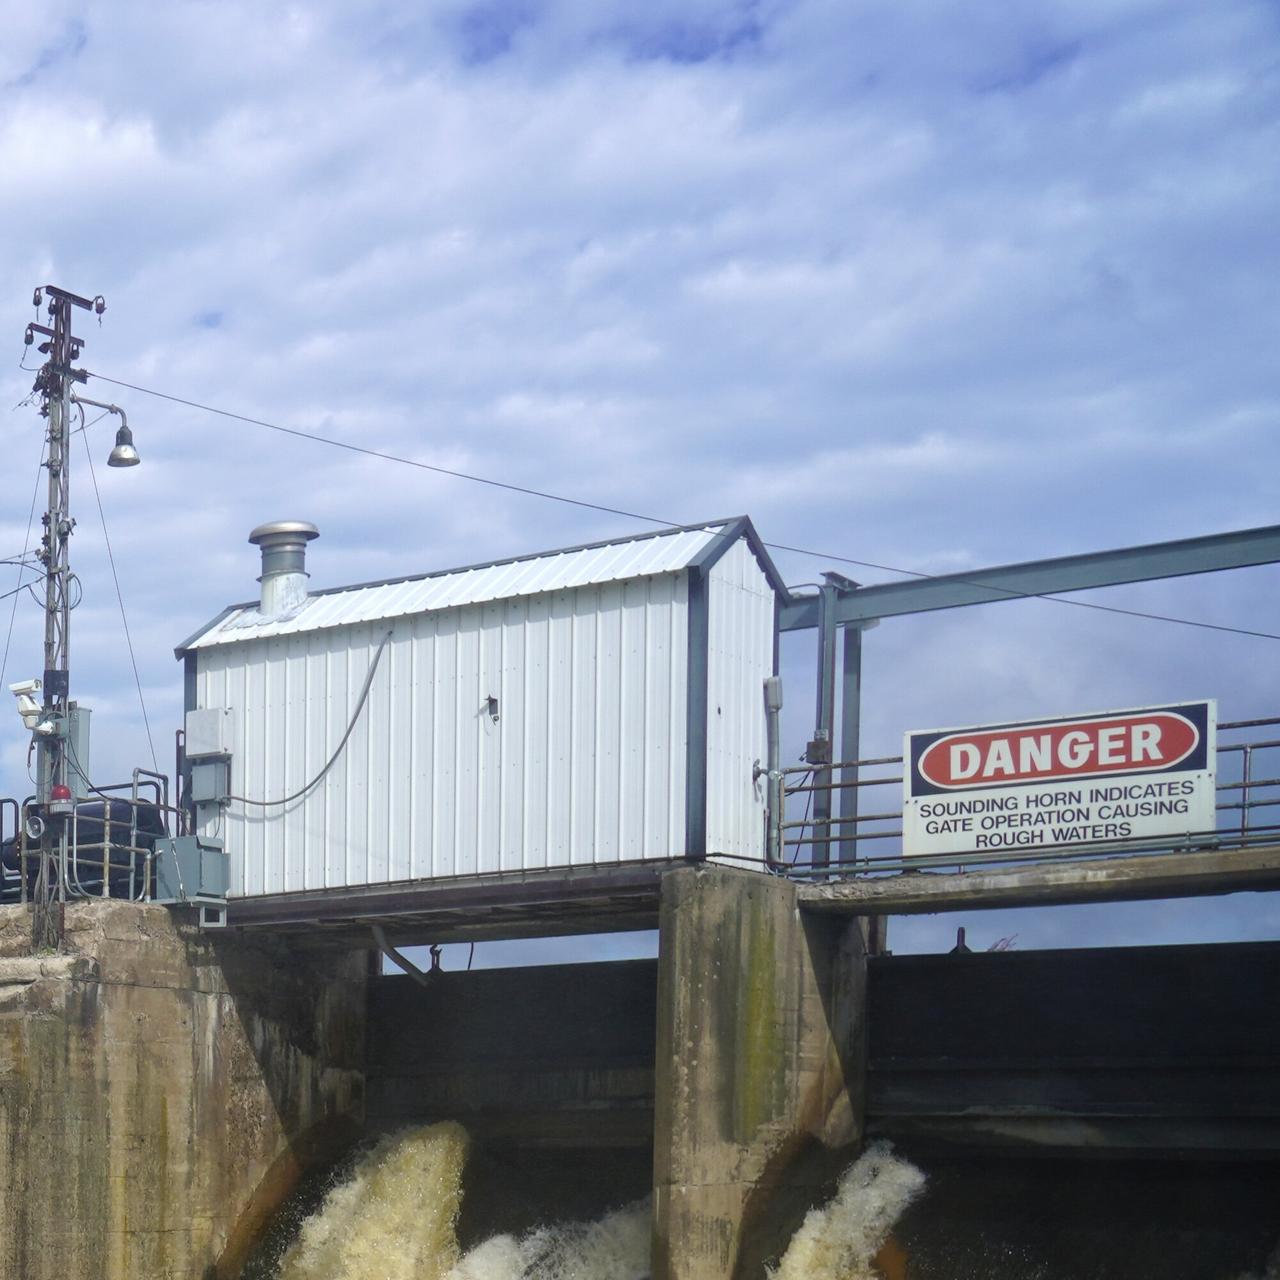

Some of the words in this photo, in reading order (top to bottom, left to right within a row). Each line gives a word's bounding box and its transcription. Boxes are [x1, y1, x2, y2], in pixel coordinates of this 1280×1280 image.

[950, 724, 1163, 780] DANGER
[920, 796, 1019, 818] SOUNDING
[1026, 790, 1082, 809] HORN
[1090, 780, 1194, 803] INDICATES
[925, 817, 973, 835] GATE
[981, 808, 1090, 831] OPERATION
[1098, 800, 1188, 821] CAUSING
[976, 830, 1043, 849] ROUGH
[1051, 822, 1132, 842] WATERS
